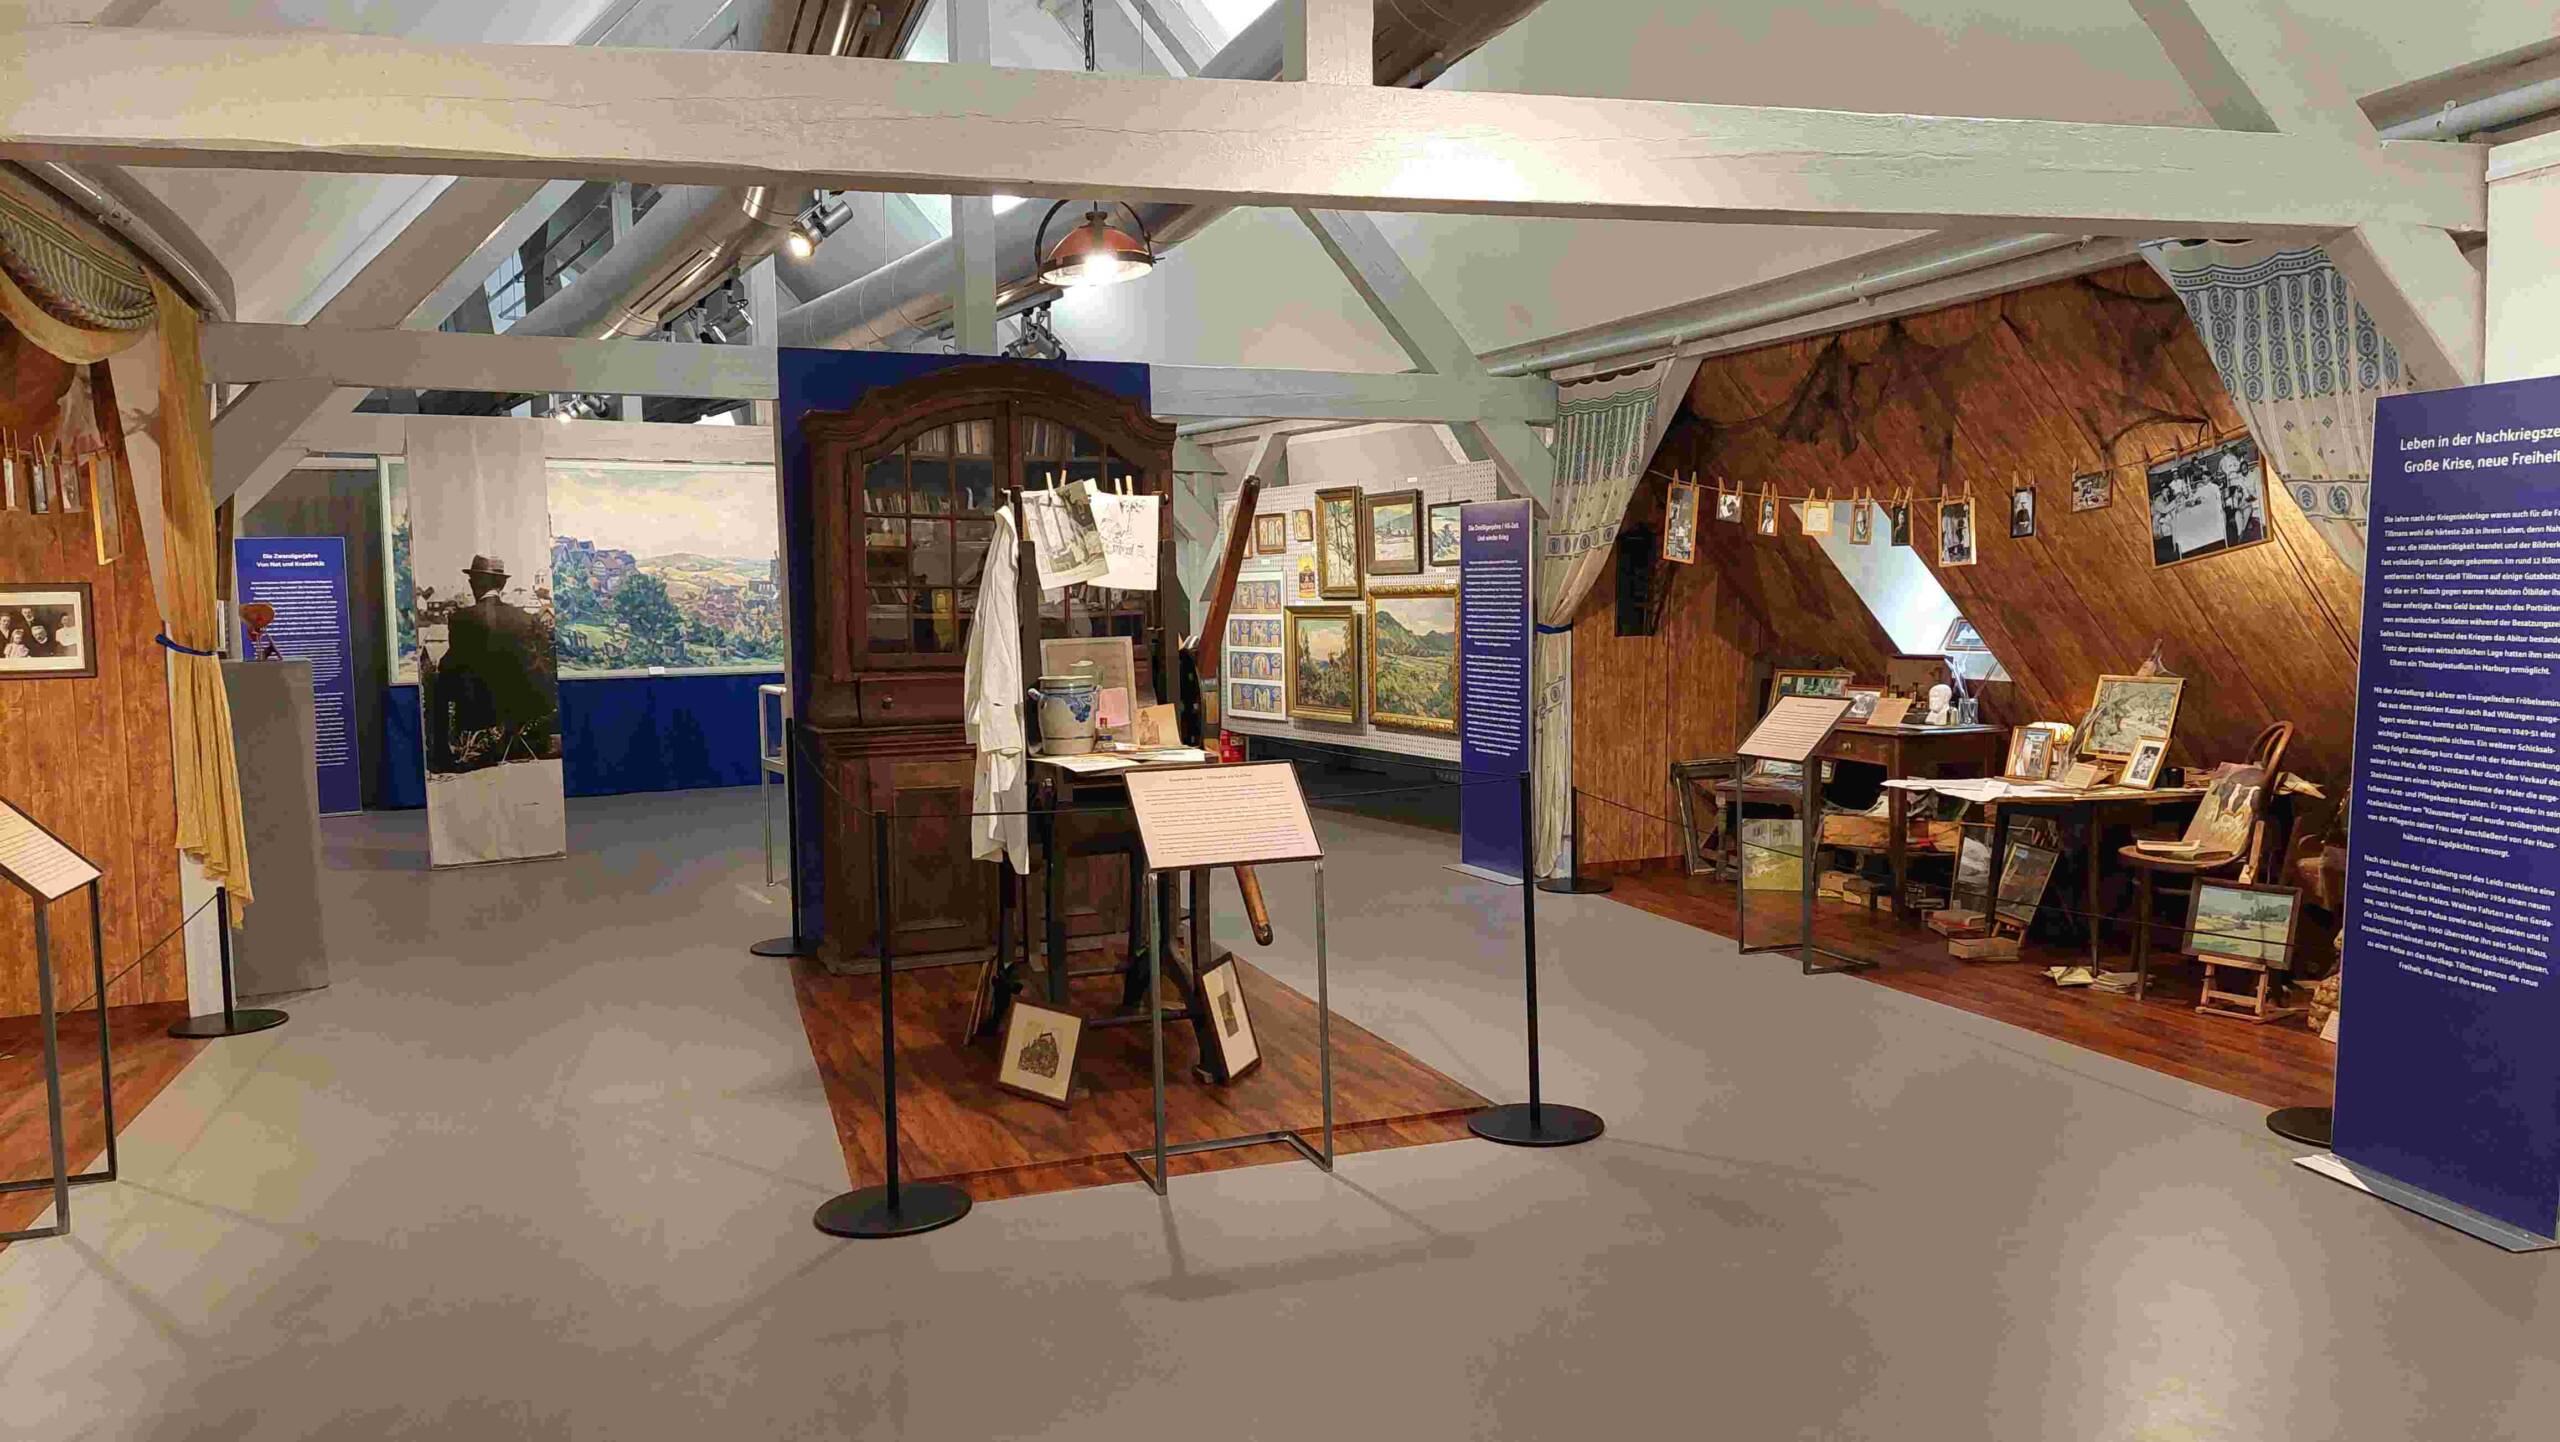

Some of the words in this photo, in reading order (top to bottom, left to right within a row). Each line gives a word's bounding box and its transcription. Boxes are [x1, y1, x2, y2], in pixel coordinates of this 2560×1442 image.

[2401, 437, 2435, 451] Leben
[2438, 435, 2449, 447] in
[2452, 434, 2472, 446] der
[2476, 428, 2560, 444] Nachkriegsze
[2405, 459, 2439, 473] Große
[2442, 457, 2475, 470] Krise,
[2478, 456, 2508, 468] neue
[2512, 449, 2560, 465] Freiheit
[2546, 808, 2560, 817] sein
